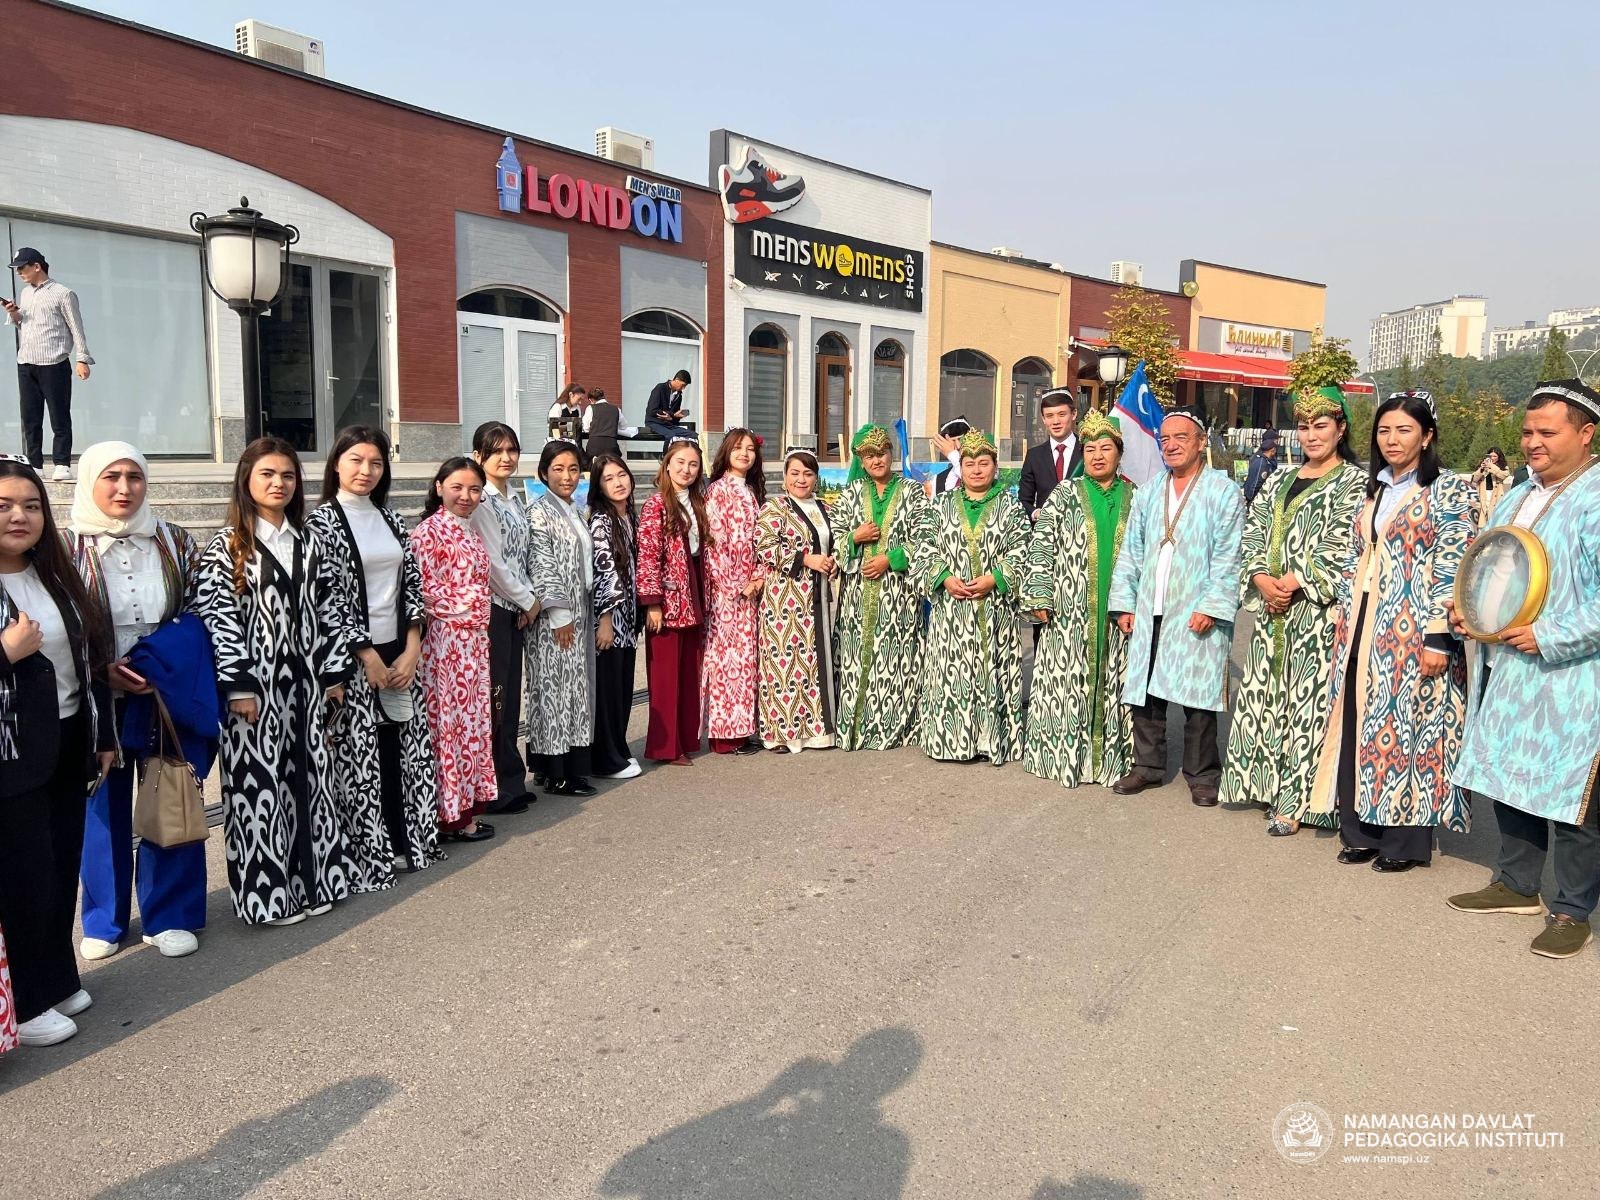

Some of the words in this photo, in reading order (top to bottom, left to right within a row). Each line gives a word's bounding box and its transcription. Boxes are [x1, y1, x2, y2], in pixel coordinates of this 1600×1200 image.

[526, 165, 683, 244] LONDON
[629, 177, 657, 199] MEN'S
[657, 184, 681, 201] WEAR
[752, 229, 811, 266] MENS
[904, 254, 915, 299] SHOP
[462, 326, 469, 334] 14
